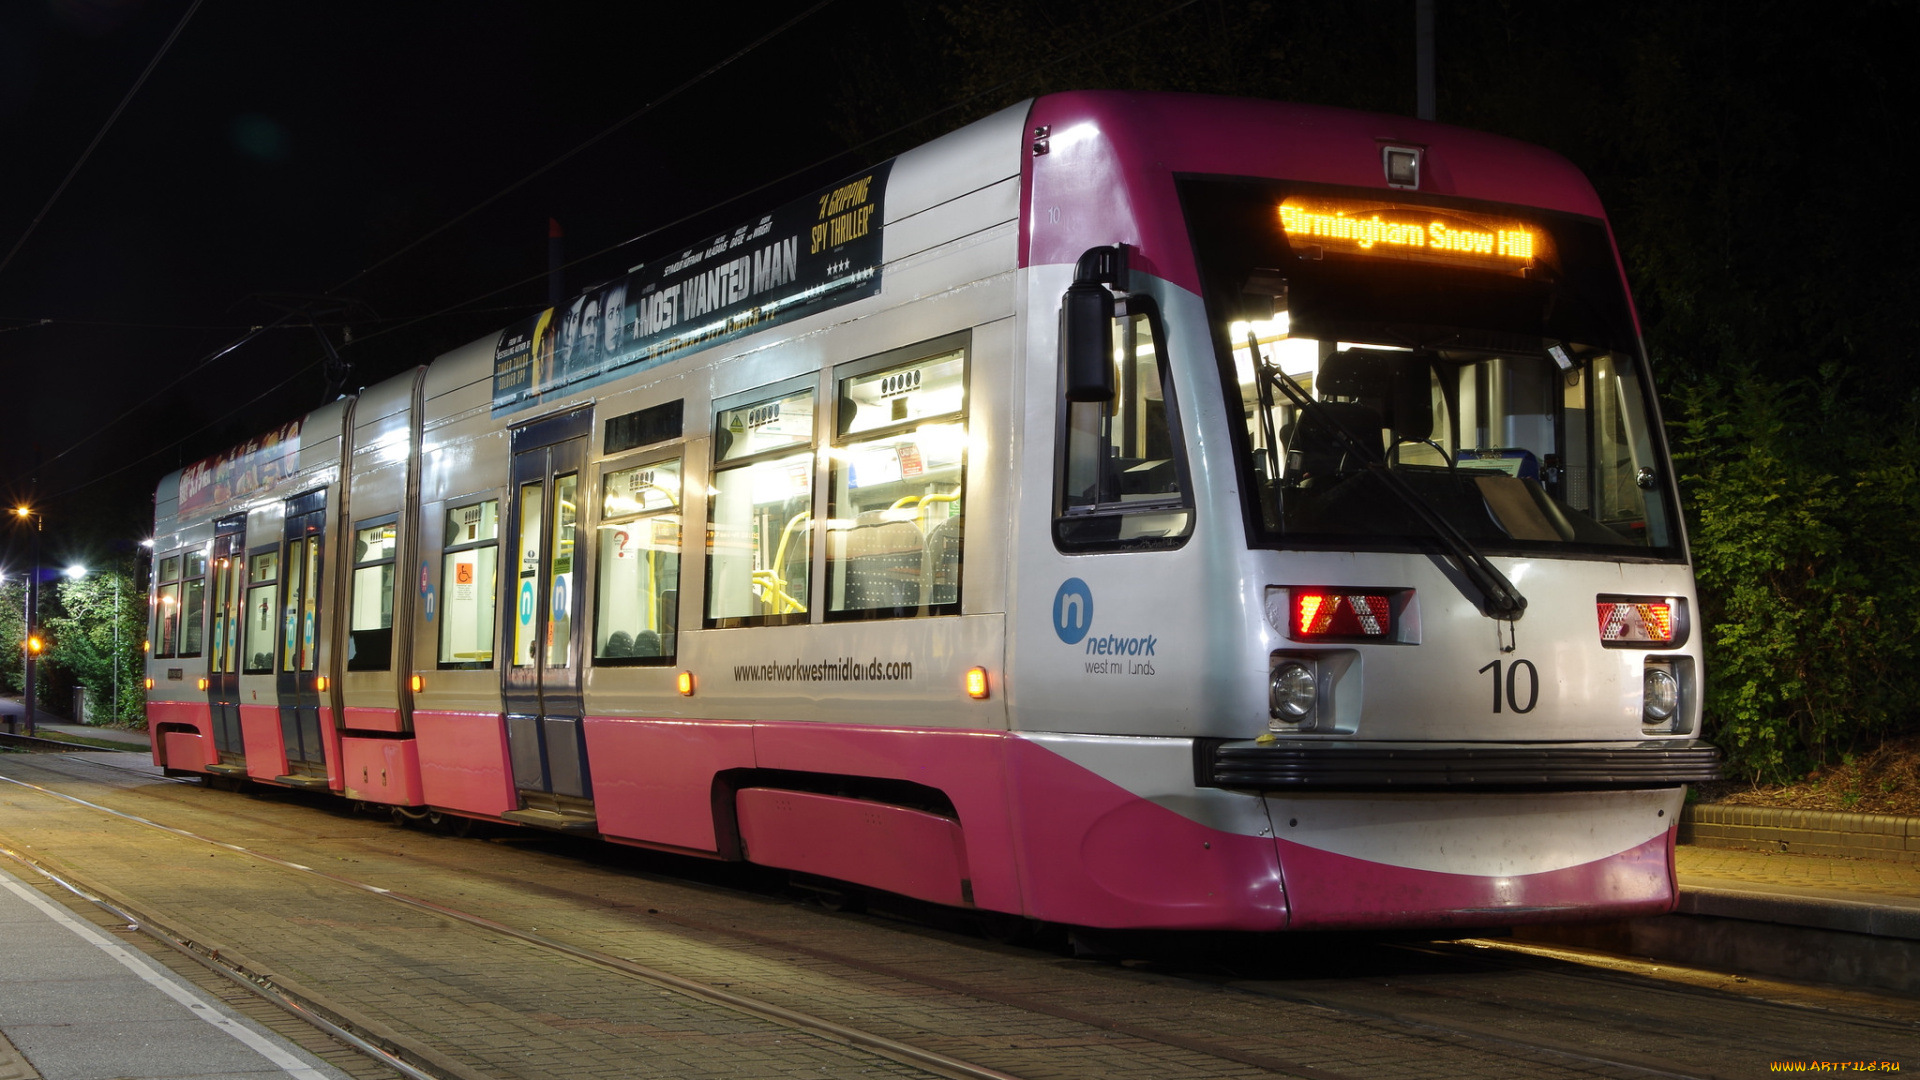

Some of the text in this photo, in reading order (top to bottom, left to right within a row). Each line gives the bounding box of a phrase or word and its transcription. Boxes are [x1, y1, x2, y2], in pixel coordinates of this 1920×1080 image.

[811, 203, 875, 255] SPY THRILLER"
[1048, 206, 1061, 224] 10
[1279, 204, 1533, 259] Birmingham Snow Hill
[640, 283, 681, 338] MOST
[683, 255, 751, 322] WANTED
[753, 235, 798, 295] MAN
[1086, 634, 1158, 656] network
[734, 656, 913, 682] www.networkwestmidlands.com
[1085, 659, 1109, 674] west
[1478, 658, 1539, 714] 10
